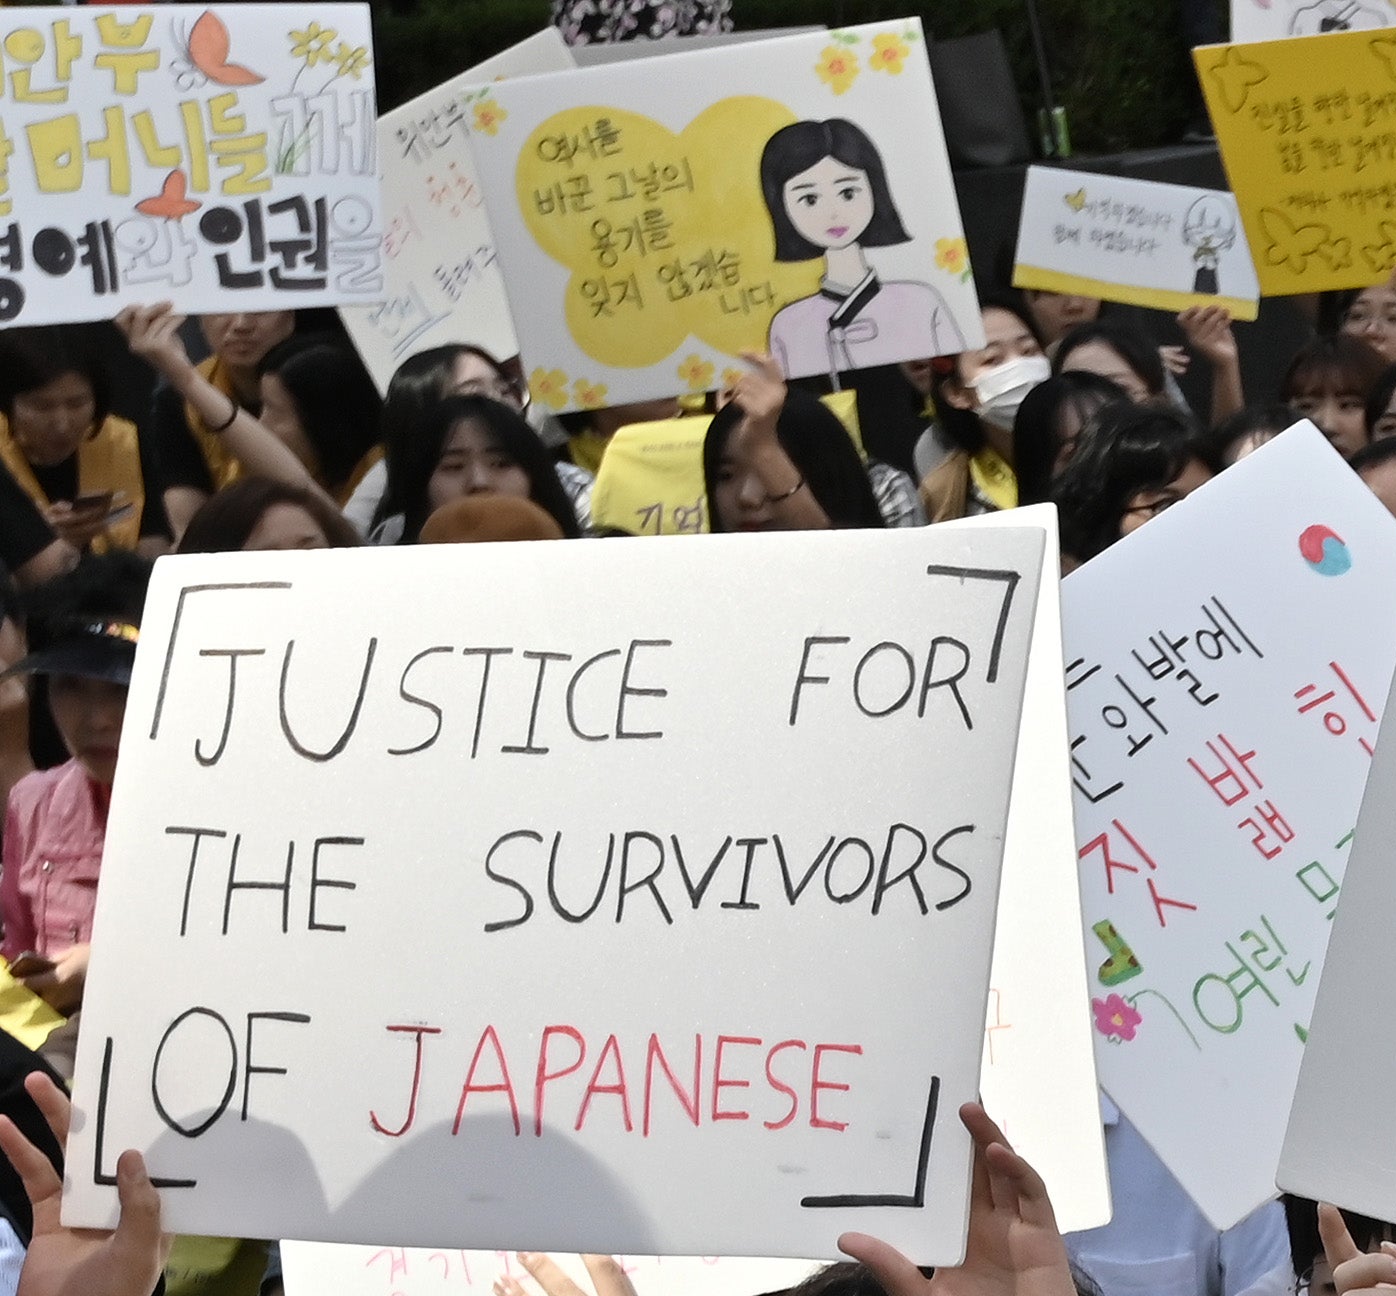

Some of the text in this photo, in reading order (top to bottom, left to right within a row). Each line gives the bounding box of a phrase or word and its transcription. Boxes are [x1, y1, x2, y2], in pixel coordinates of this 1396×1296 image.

[0, 14, 160, 103] 안부
[0, 88, 378, 213] 머니들께
[534, 156, 695, 216] 바꾼 그날의
[537, 118, 623, 168] 역사를
[199, 194, 384, 295] 인권을
[590, 207, 675, 268] 용기를
[580, 272, 643, 318] 잊지
[195, 636, 973, 766] JUSTICE FOR
[165, 824, 974, 936] THE SURVIVORS
[152, 1007, 310, 1138] OF
[370, 1024, 863, 1138] JAPANESE
